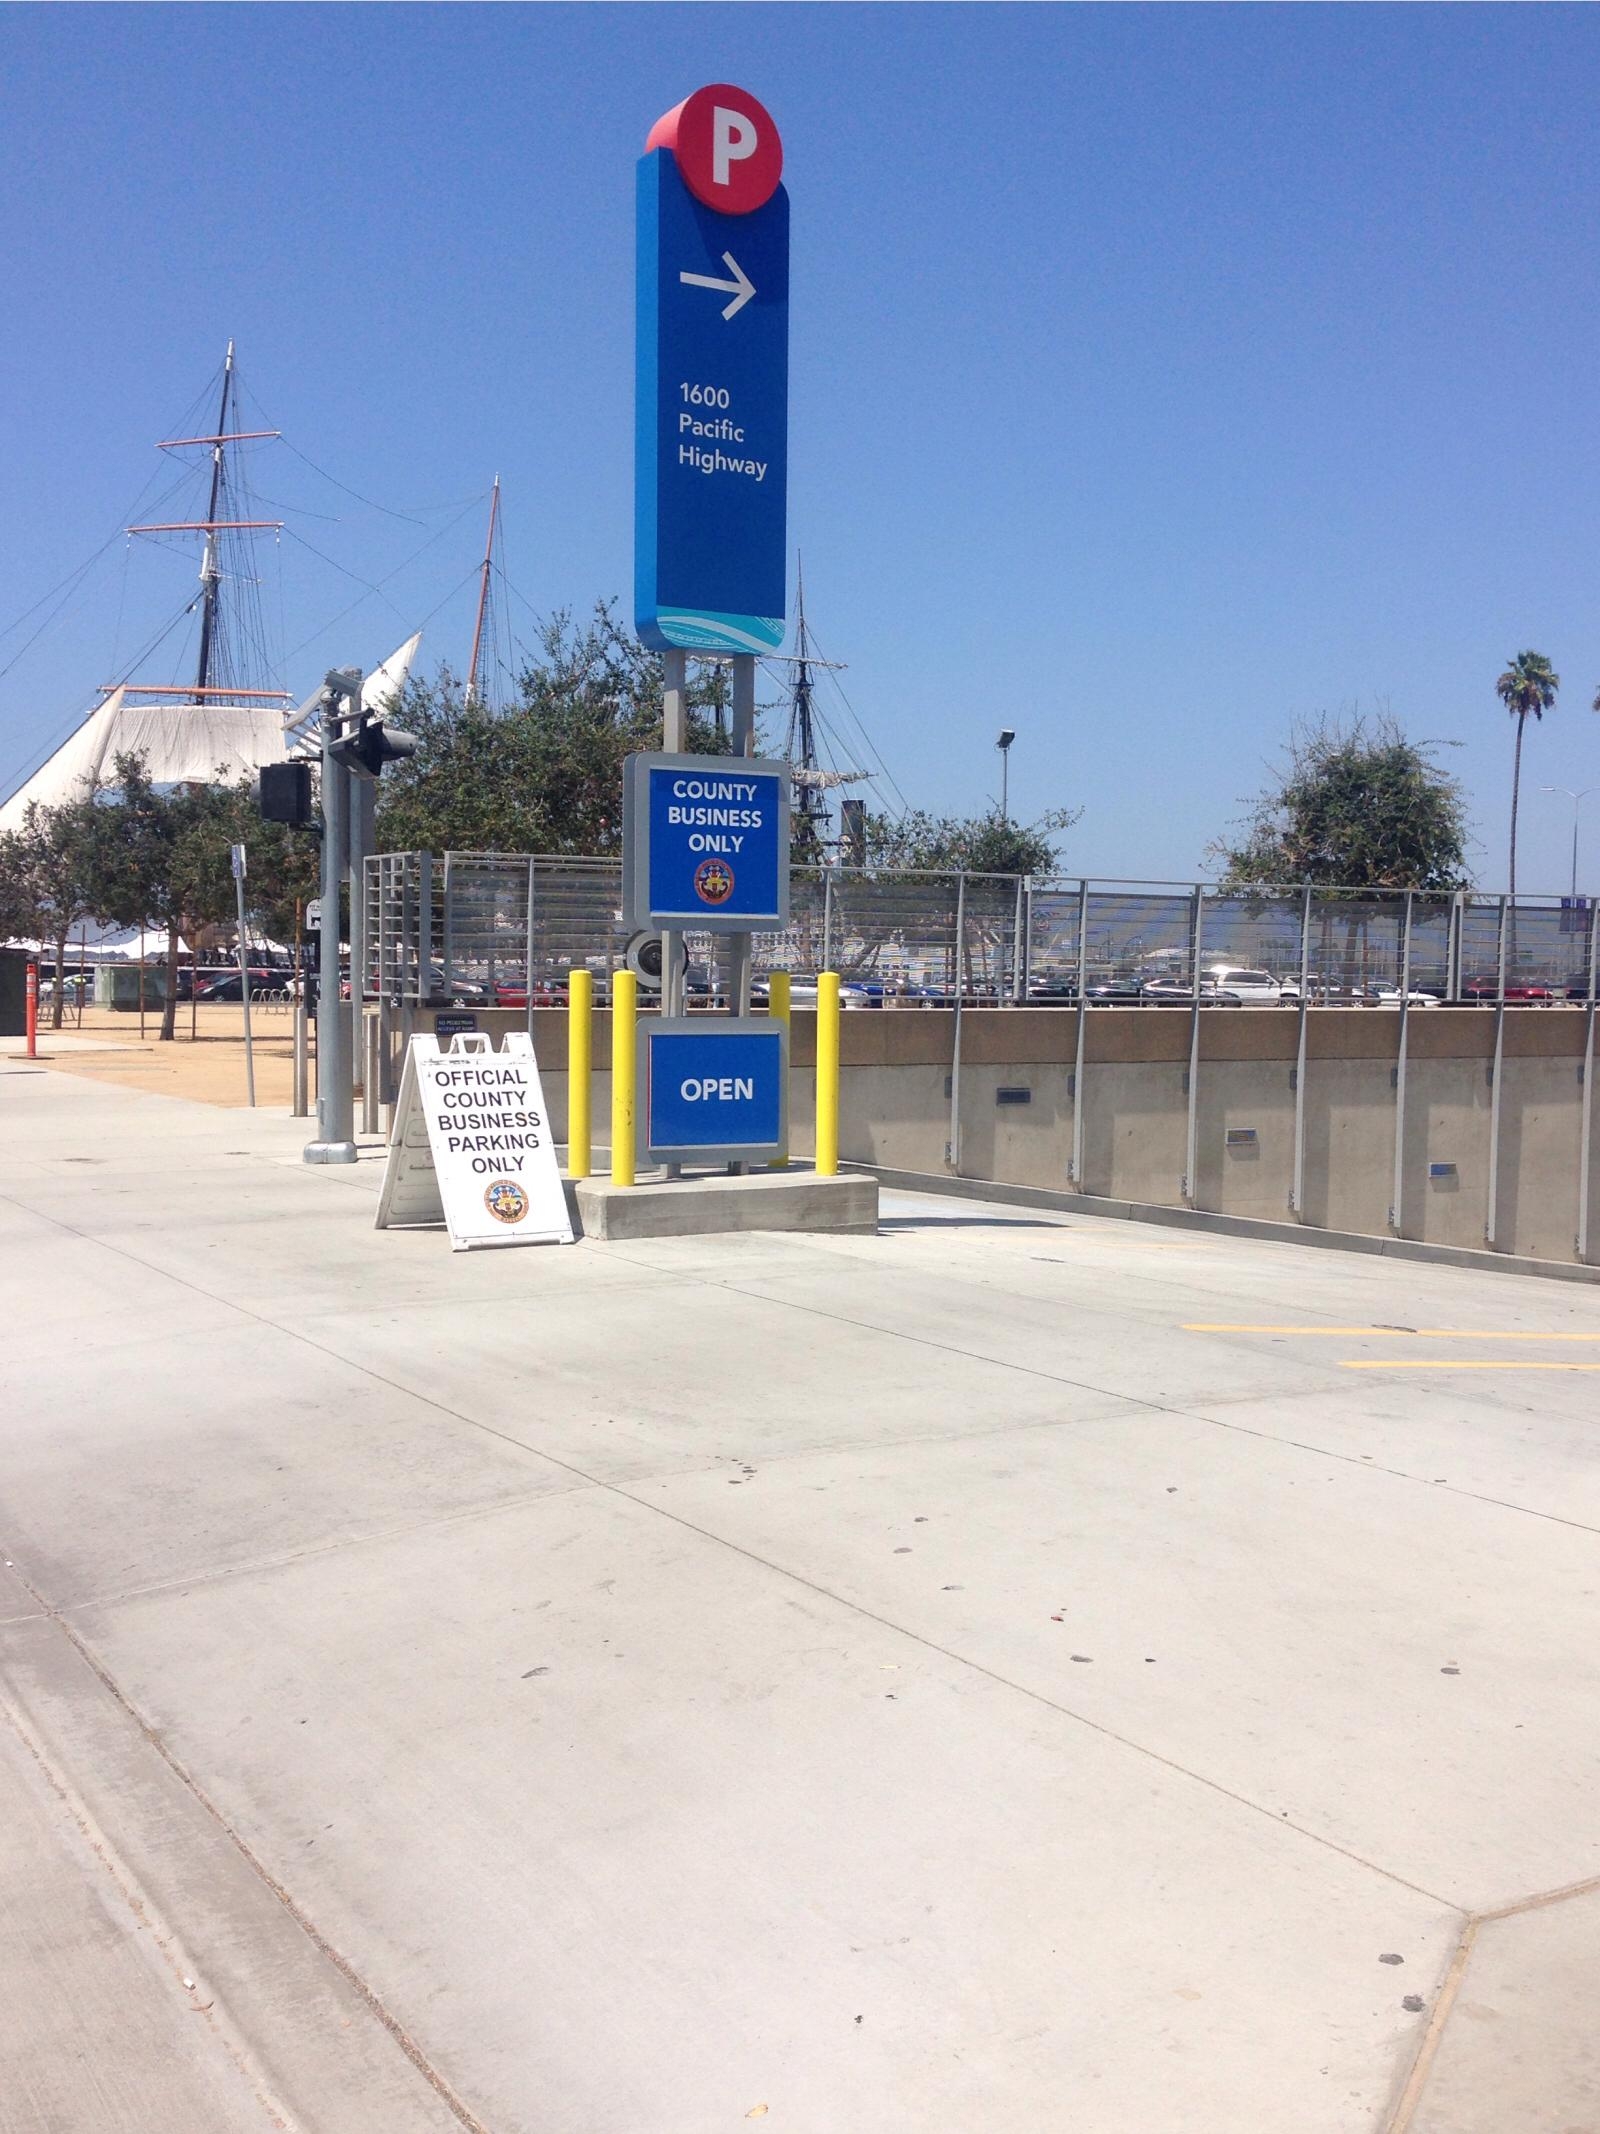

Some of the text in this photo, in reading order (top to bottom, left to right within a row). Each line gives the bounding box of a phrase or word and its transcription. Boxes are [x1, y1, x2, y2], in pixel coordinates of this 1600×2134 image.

[713, 105, 758, 186] P
[680, 382, 730, 409] 1600
[679, 413, 745, 443] Pacific
[679, 444, 768, 482] Highway
[673, 780, 757, 801] COUNTY
[668, 806, 762, 828] BUSINESS
[688, 833, 744, 853] ONLY
[435, 1069, 528, 1087] OFFICIAL
[443, 1090, 526, 1109] COUNTY
[680, 1078, 753, 1102] OPEN
[438, 1111, 541, 1131] BUSINESS
[448, 1133, 540, 1153] PARKING
[471, 1155, 524, 1174] ONLY
